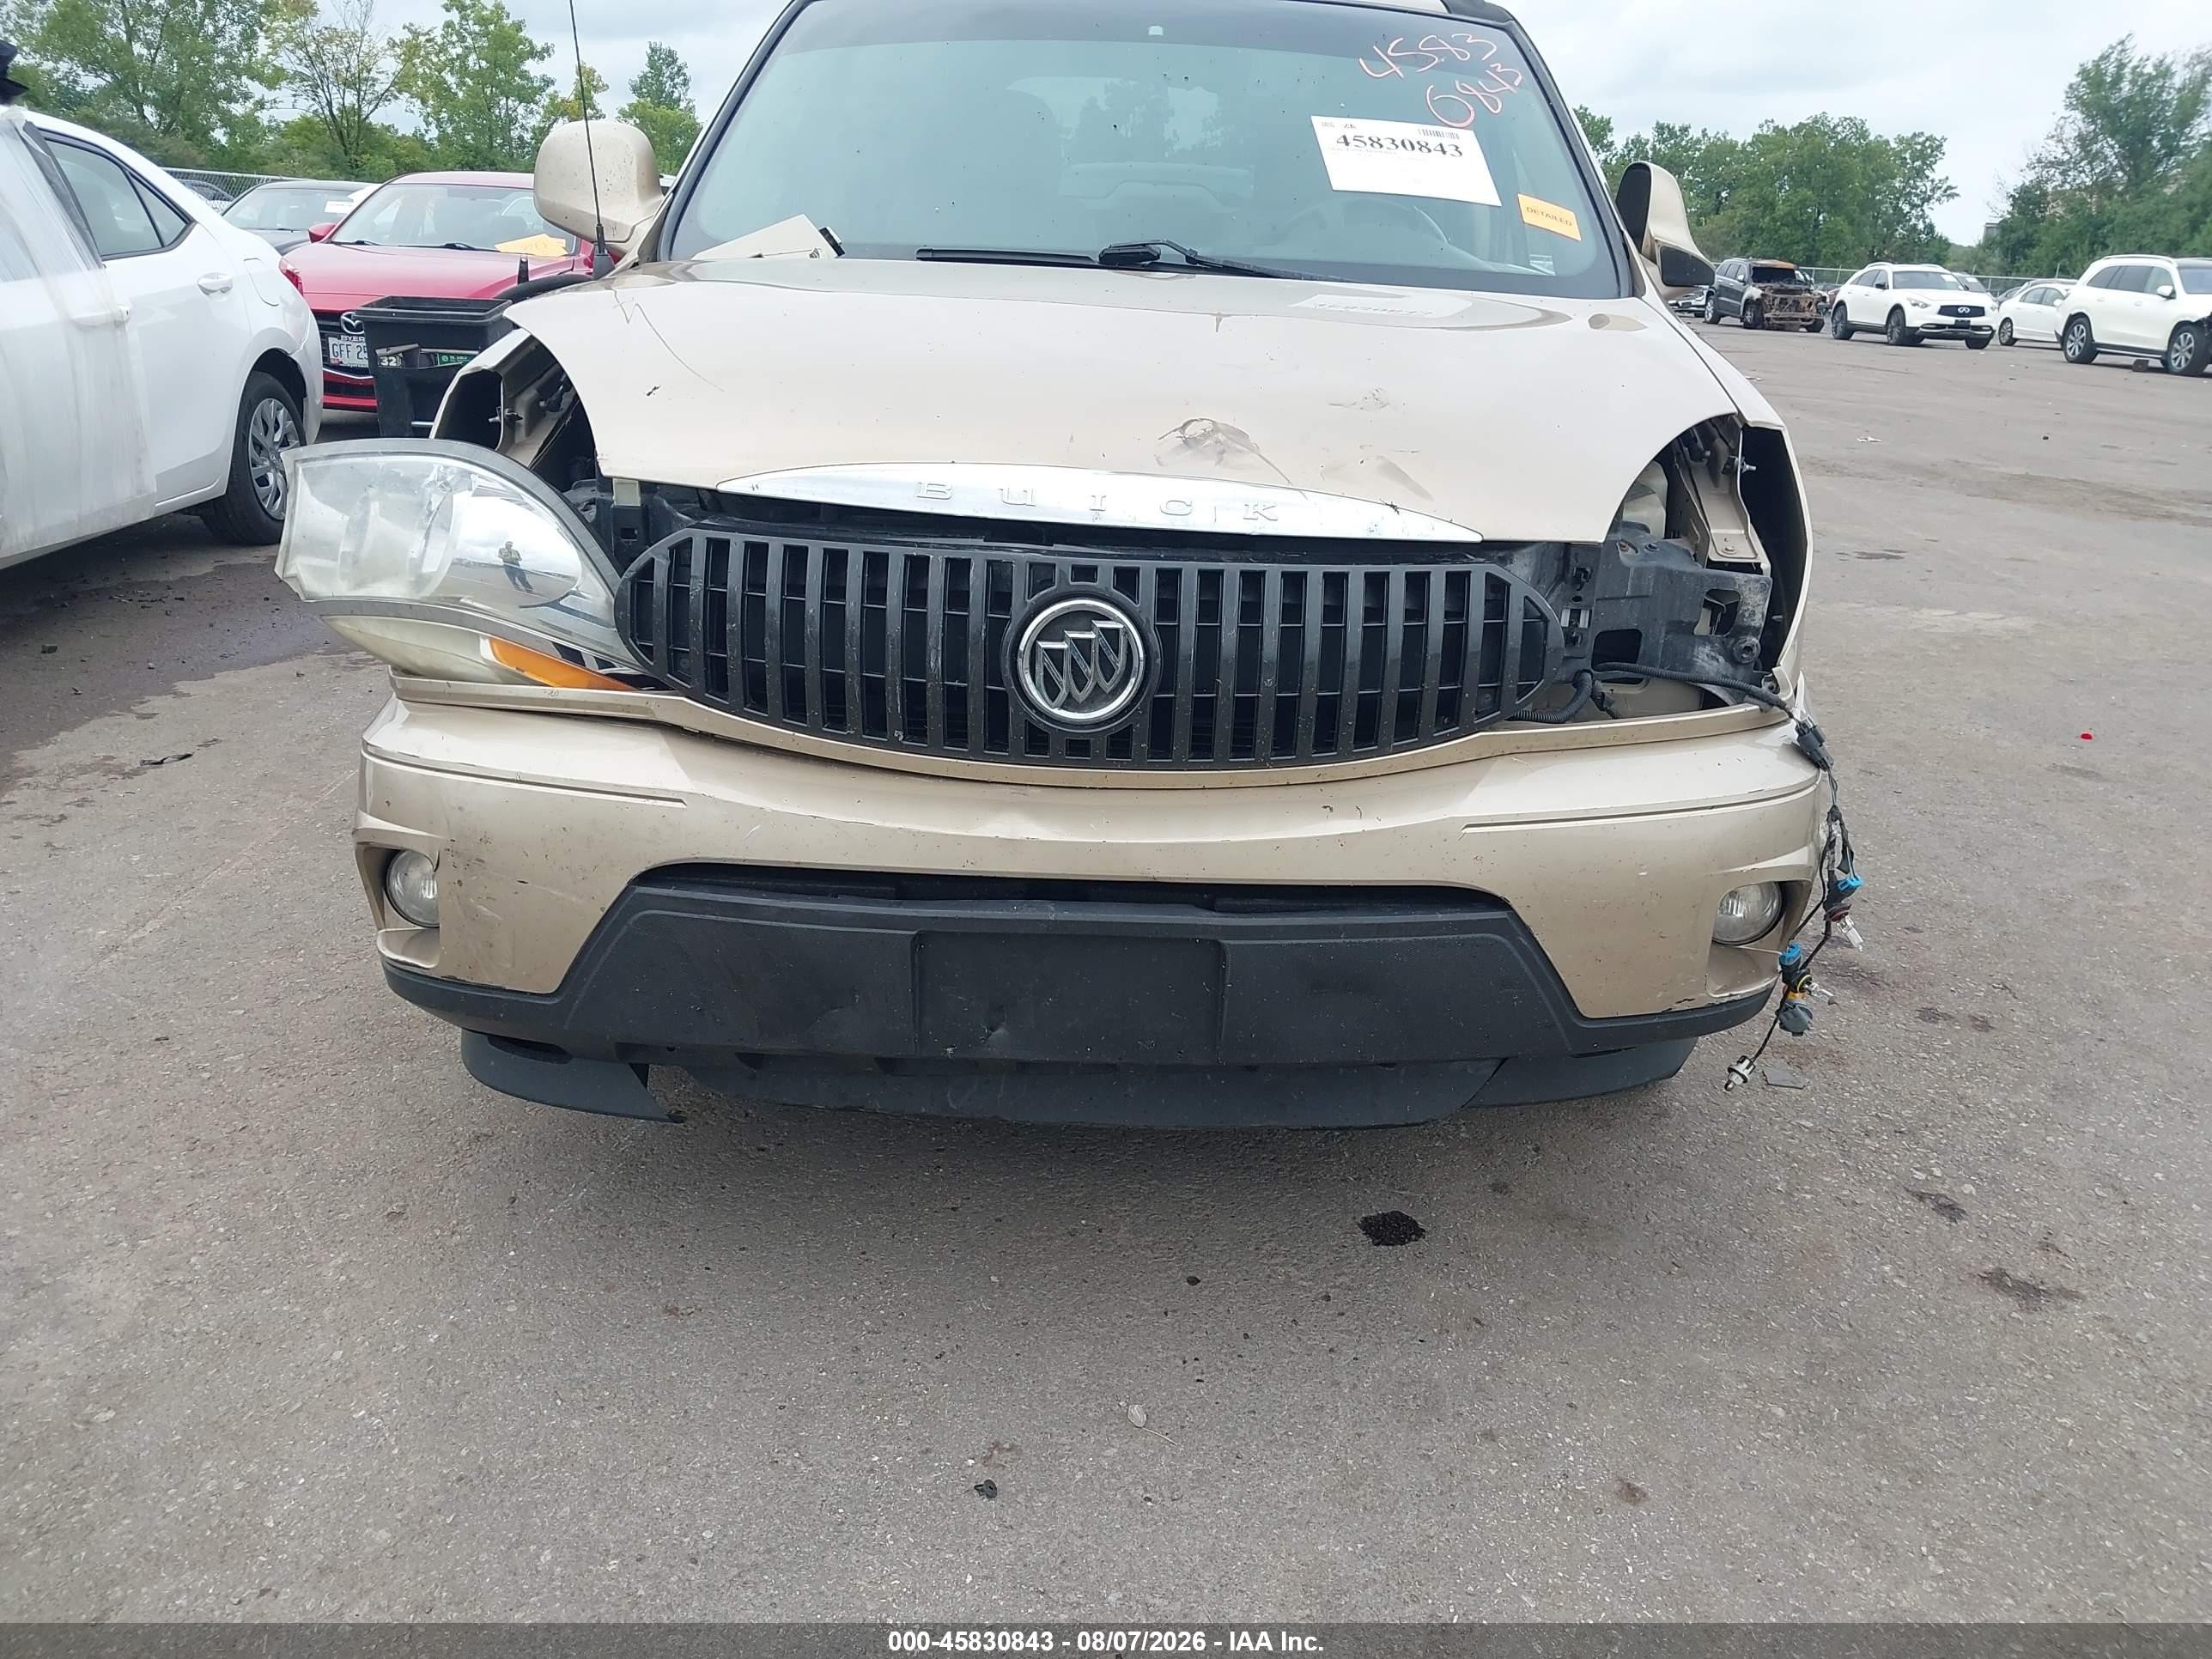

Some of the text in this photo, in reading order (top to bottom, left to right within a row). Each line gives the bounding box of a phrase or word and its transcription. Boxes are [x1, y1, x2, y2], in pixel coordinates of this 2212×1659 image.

[1358, 33, 1498, 79] 4583
[1336, 134, 1463, 158] 45830843
[1526, 206, 1572, 227] DETAILED
[331, 343, 352, 359] GFF
[380, 356, 397, 367] 32
[915, 481, 1279, 522] BUICK
